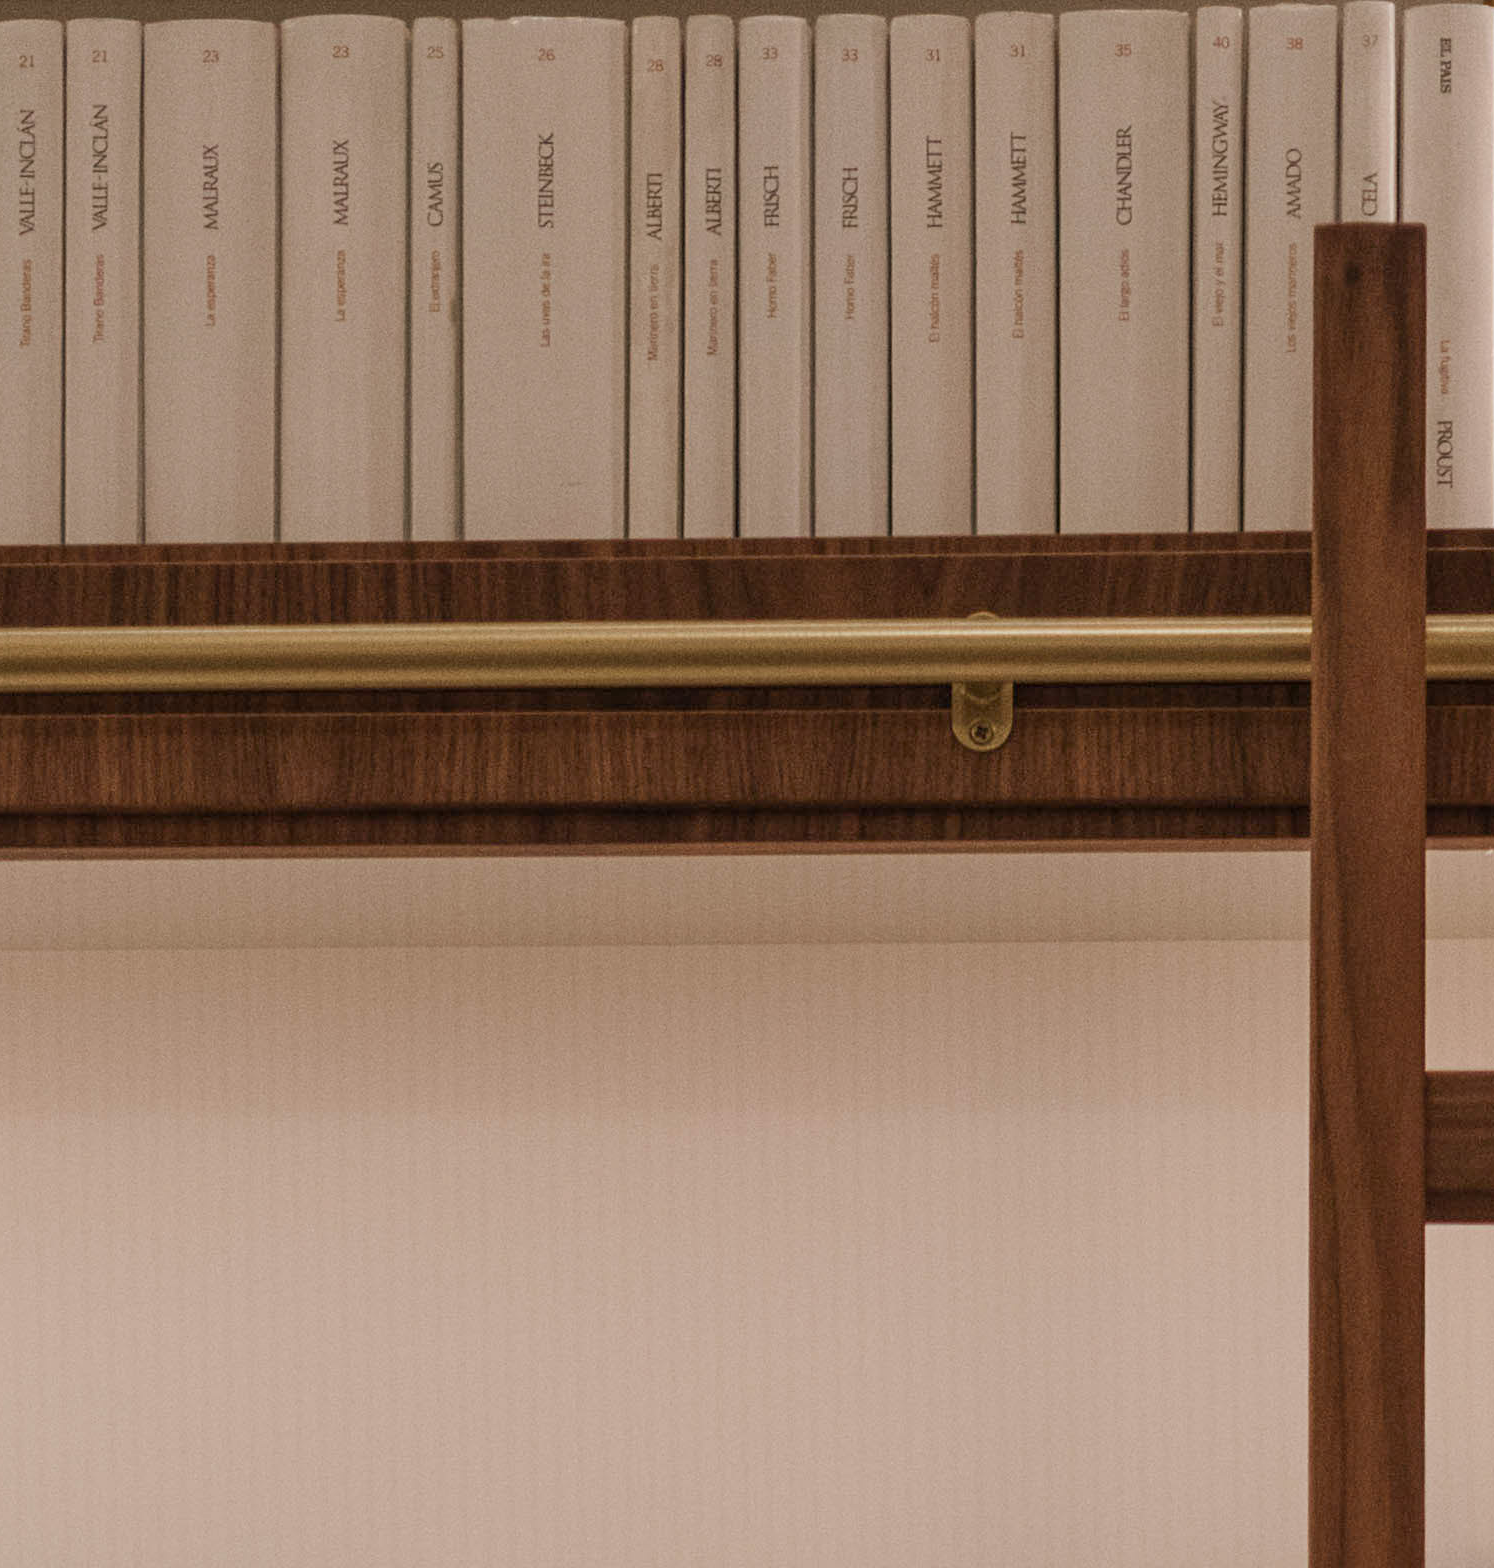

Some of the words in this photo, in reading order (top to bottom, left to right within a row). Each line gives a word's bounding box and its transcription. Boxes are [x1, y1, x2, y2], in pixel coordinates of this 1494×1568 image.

[537, 133, 555, 230] STEINBECK
[1116, 124, 1134, 226] CHANDLER
[1211, 100, 1230, 217] HEMINGWAY
[1436, 421, 1453, 488] PROUST
